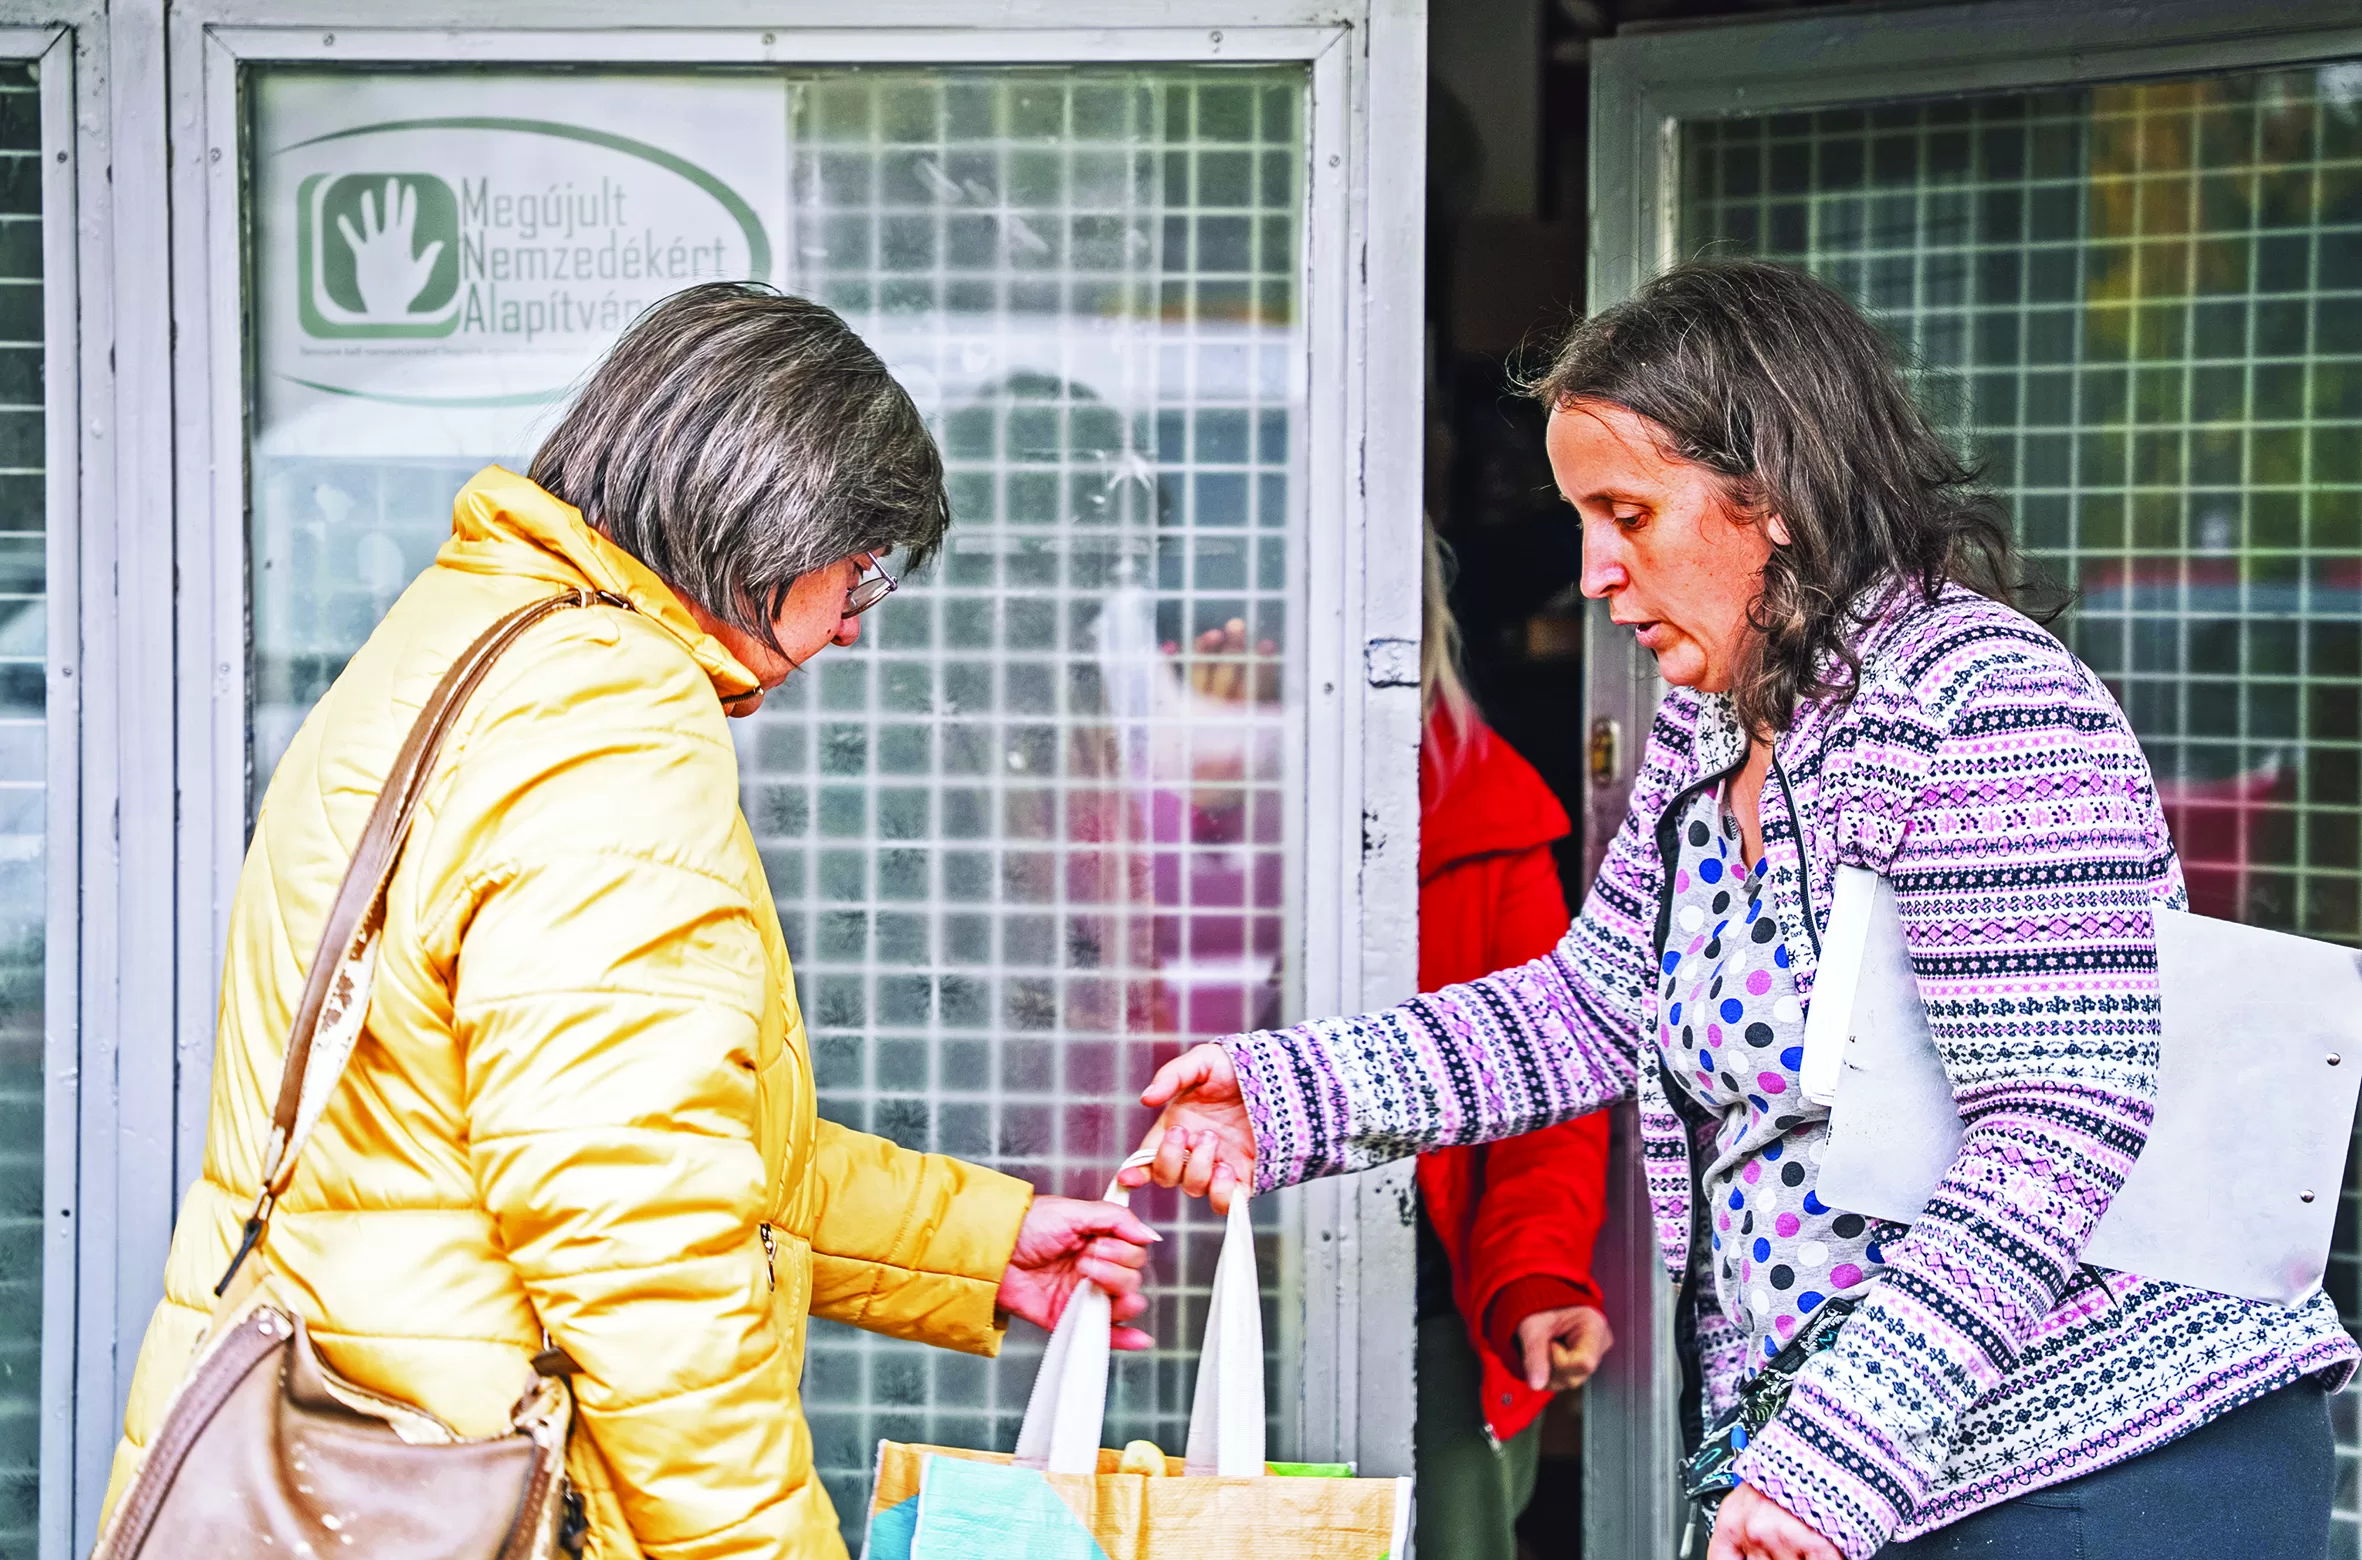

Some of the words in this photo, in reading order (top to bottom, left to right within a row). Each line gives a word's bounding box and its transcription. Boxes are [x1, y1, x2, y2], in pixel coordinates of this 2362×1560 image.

[462, 176, 628, 240] Megújult
[462, 228, 728, 281] Nemzedékért
[463, 282, 643, 344] Alapítván
